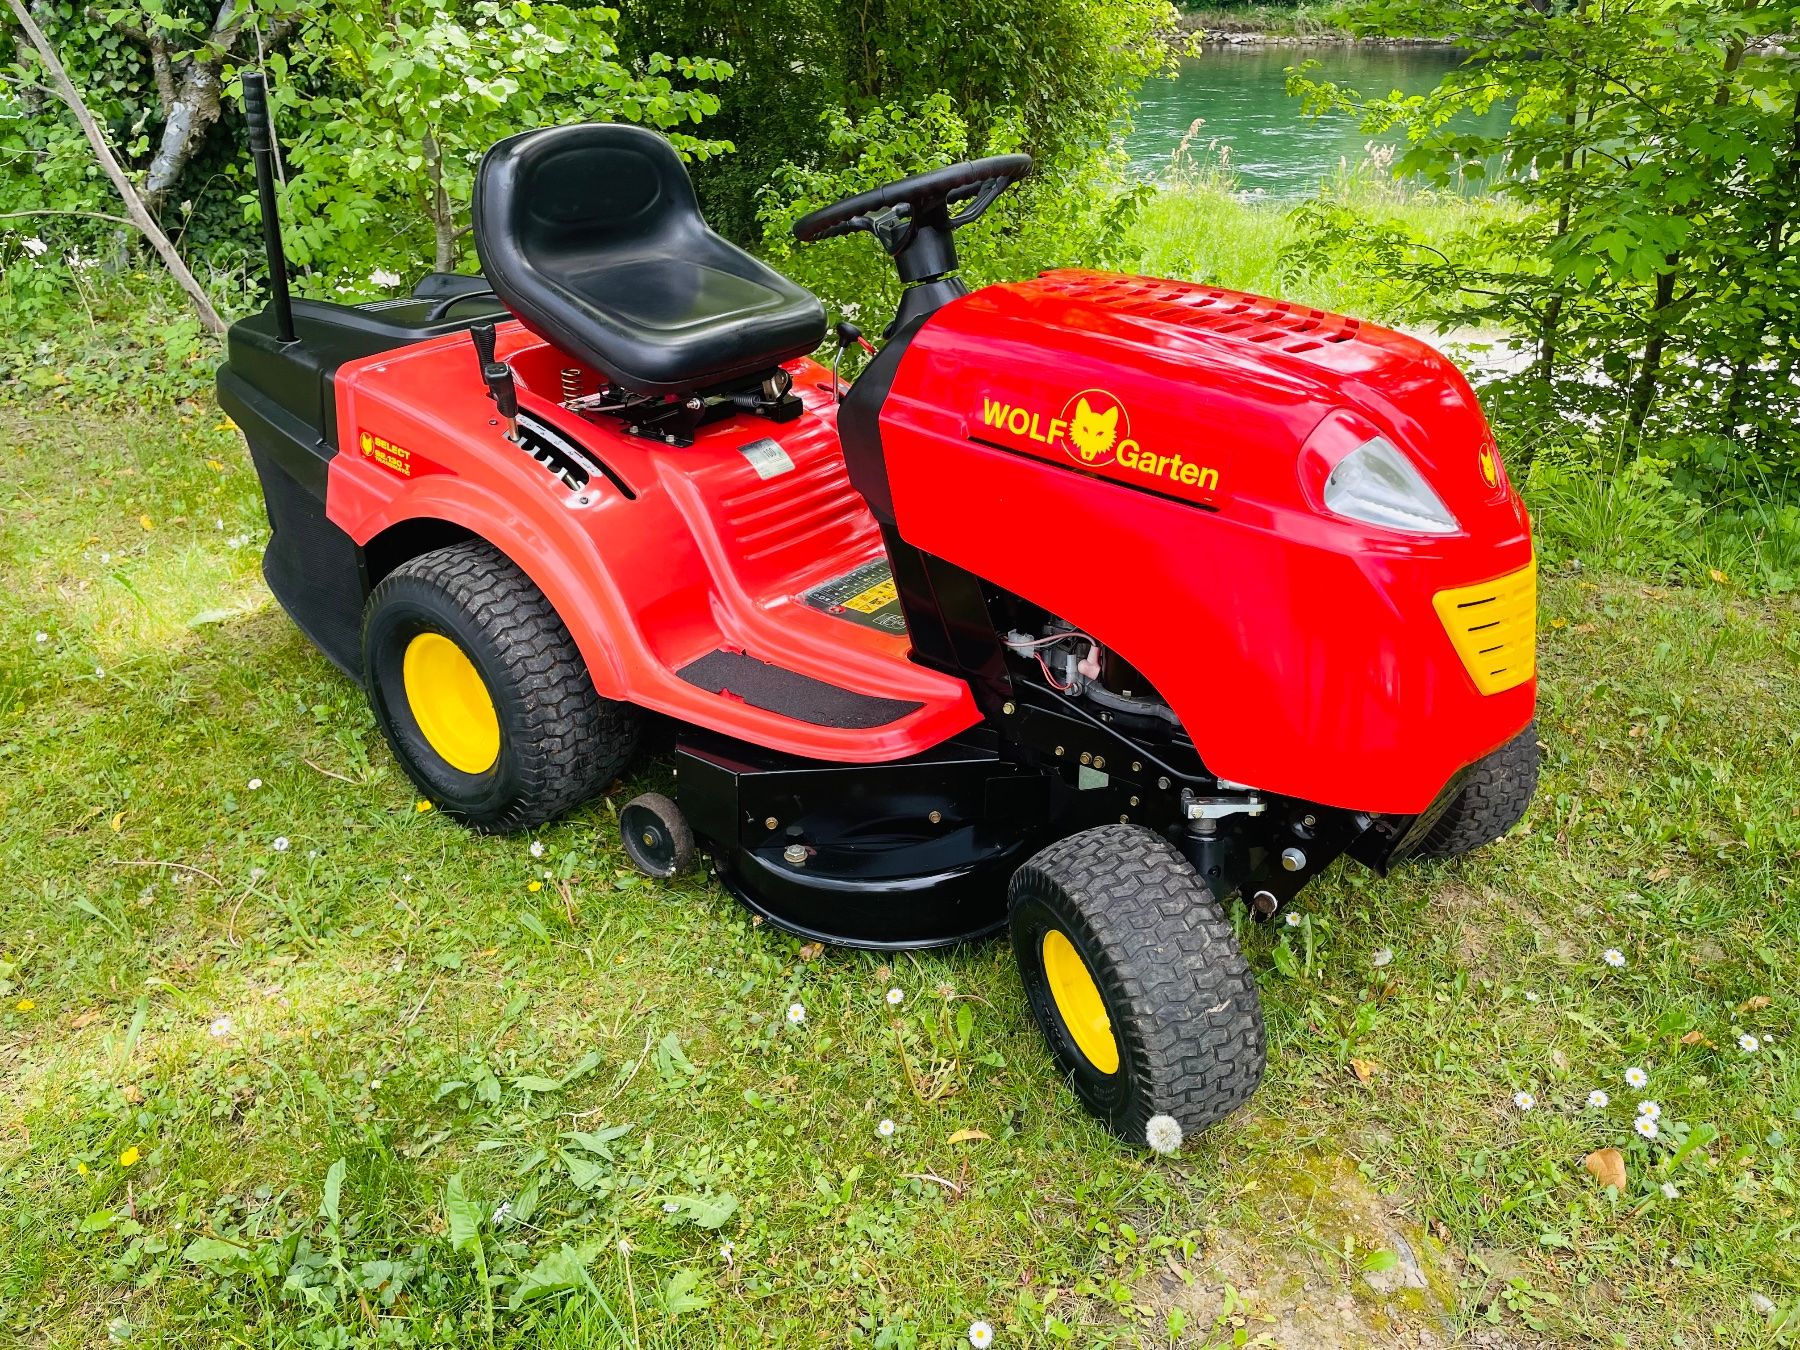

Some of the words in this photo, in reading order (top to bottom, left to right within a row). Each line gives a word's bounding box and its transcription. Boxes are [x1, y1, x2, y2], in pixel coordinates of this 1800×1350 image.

[374, 437, 410, 460] SELECT
[983, 397, 1068, 445] WOLF
[1115, 438, 1220, 491] Garten
